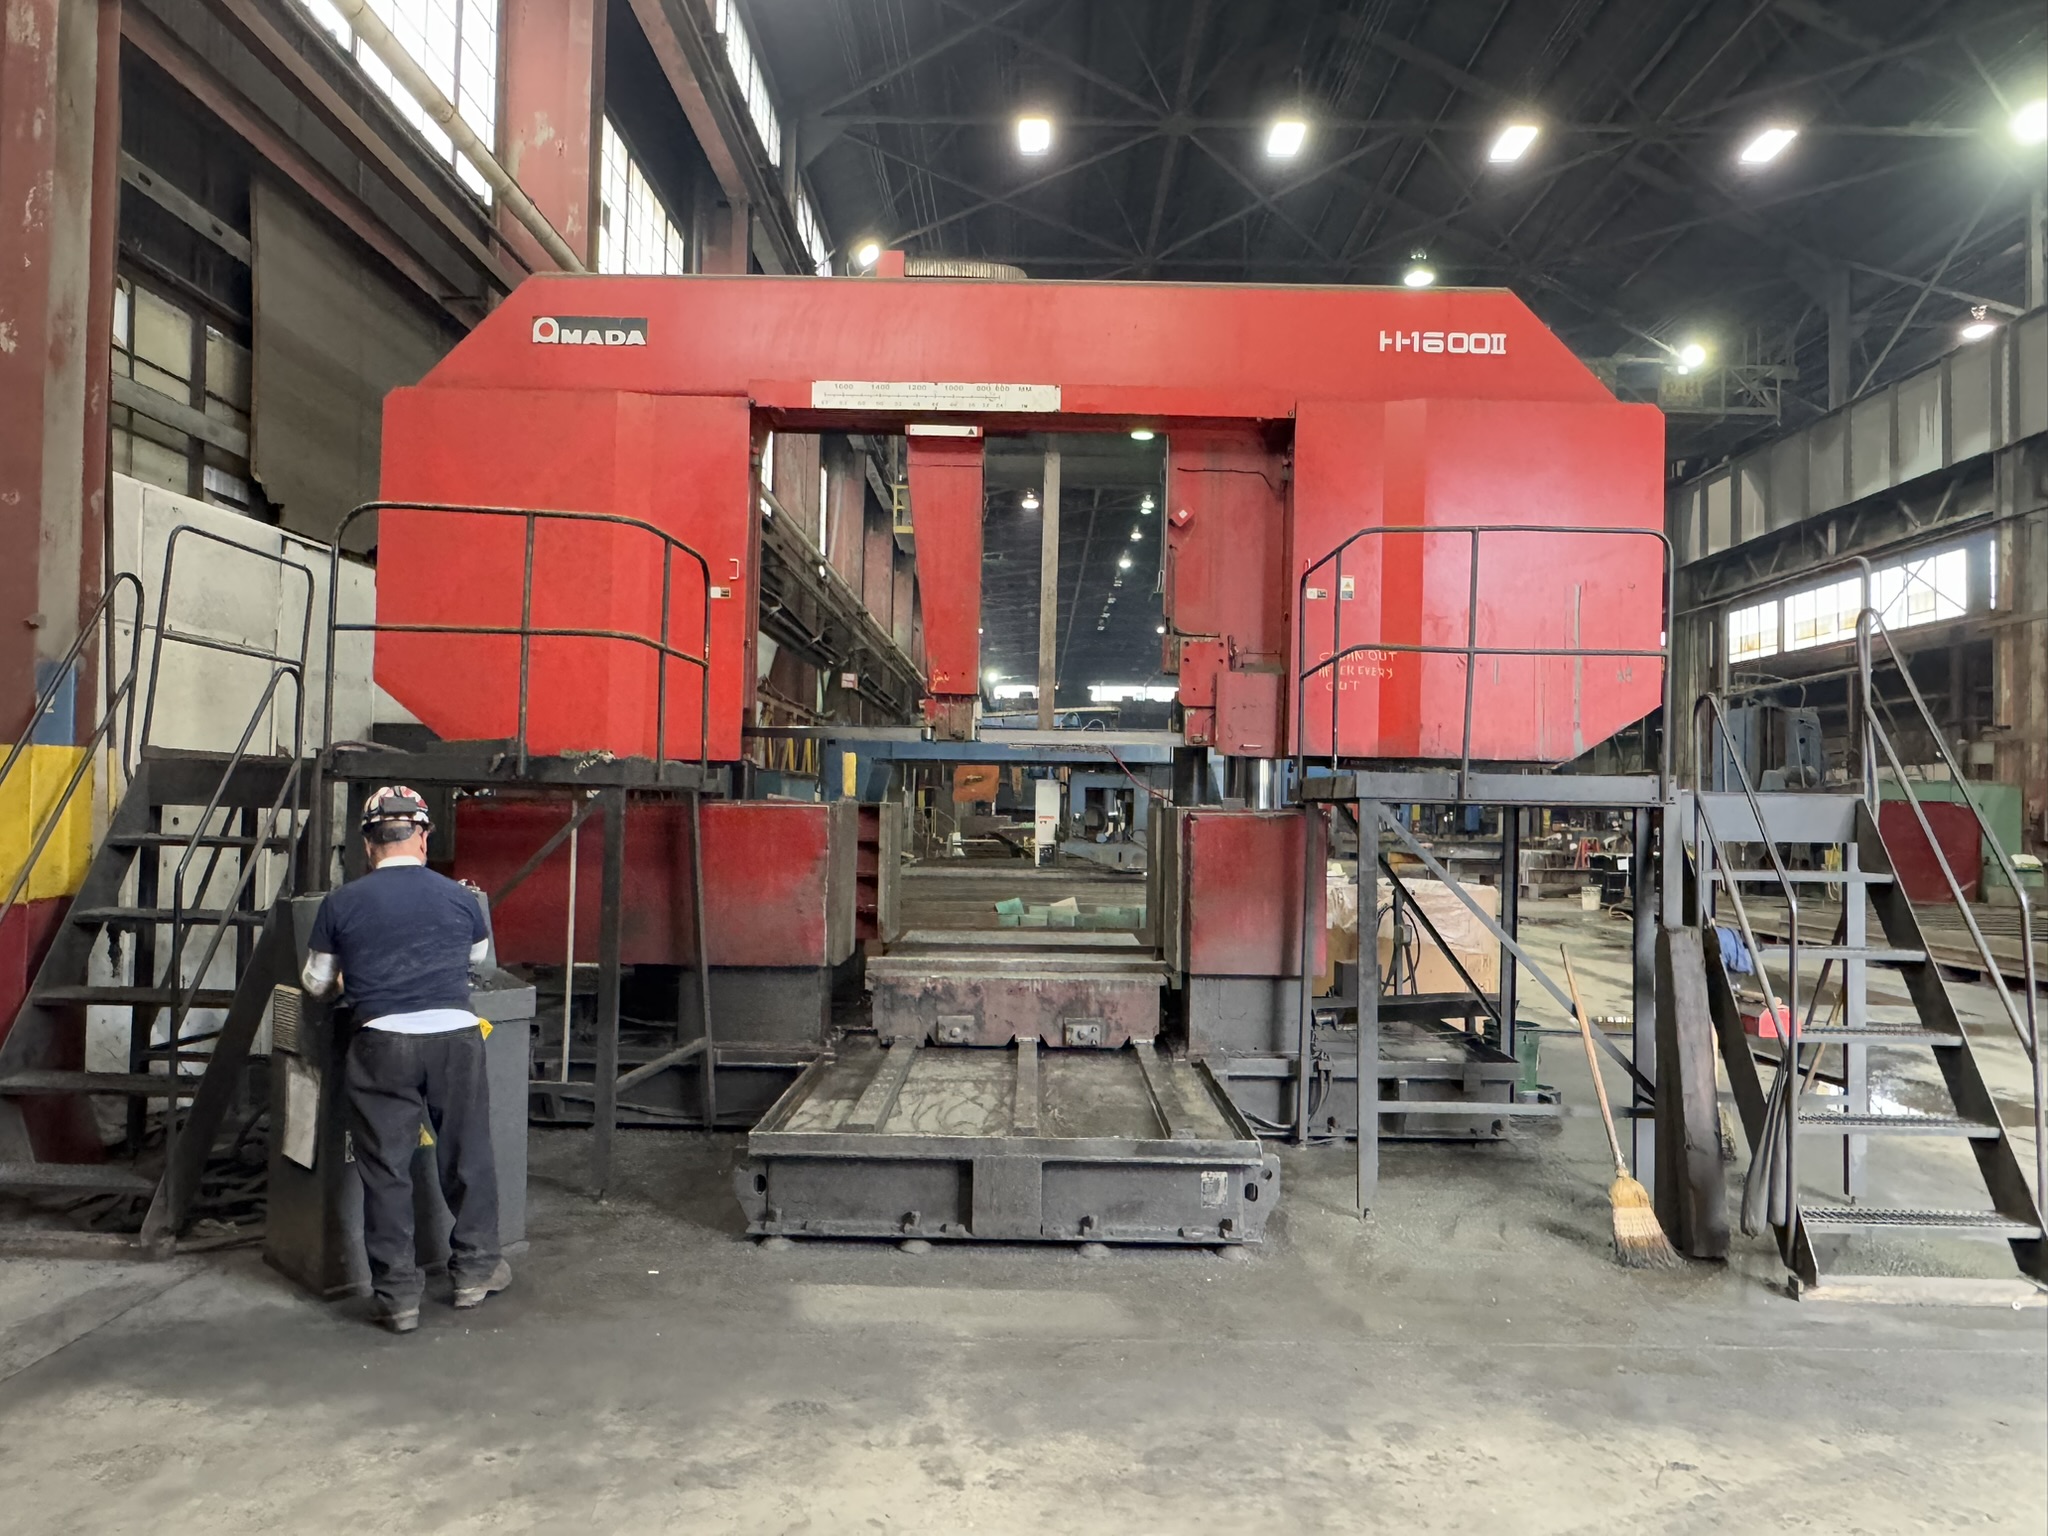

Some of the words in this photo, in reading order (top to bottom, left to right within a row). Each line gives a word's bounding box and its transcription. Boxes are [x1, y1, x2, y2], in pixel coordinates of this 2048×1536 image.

[533, 317, 646, 345] AMADA
[1319, 651, 1364, 662] CAN
[1368, 651, 1398, 662] OUT
[1318, 664, 1355, 678] AFER
[1358, 665, 1393, 680] EVERY
